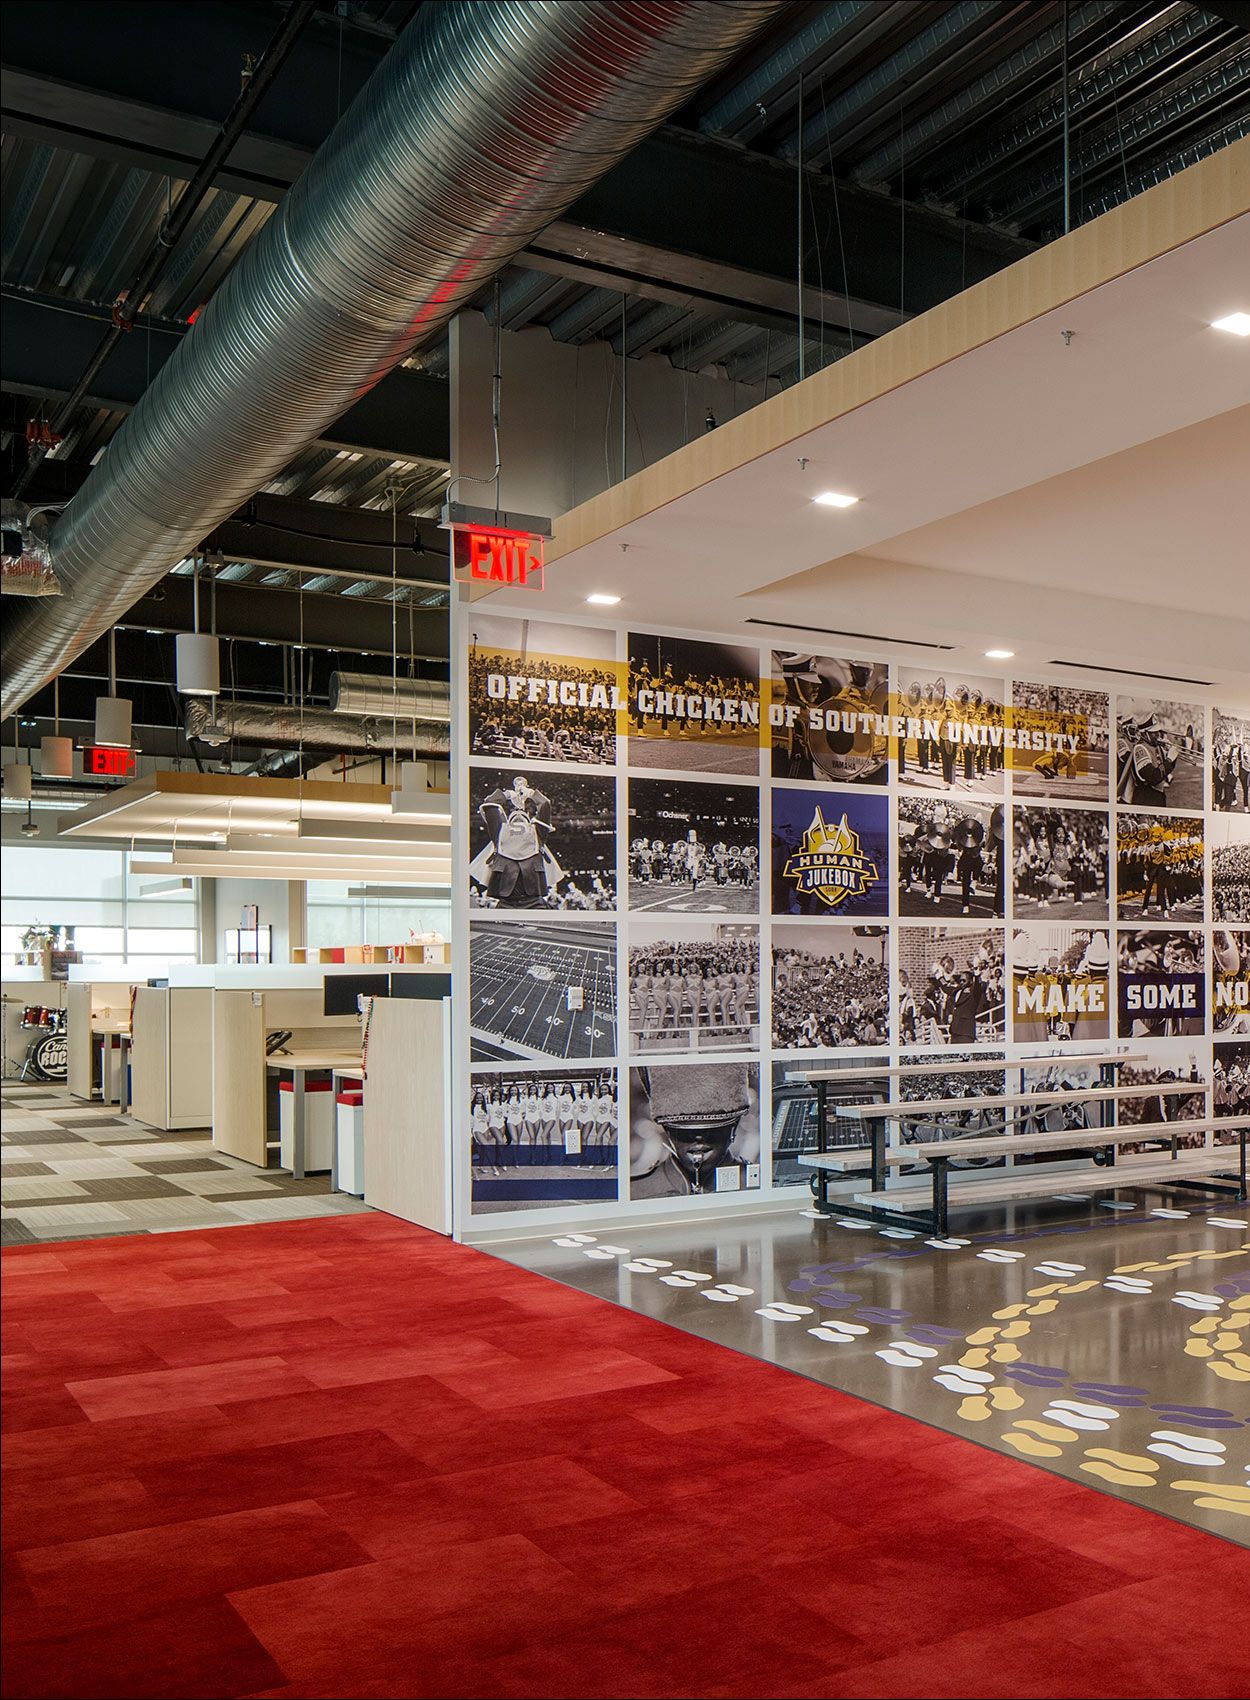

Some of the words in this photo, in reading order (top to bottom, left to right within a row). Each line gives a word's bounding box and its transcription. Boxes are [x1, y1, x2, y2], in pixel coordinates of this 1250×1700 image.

[470, 534, 530, 584] EXIT
[487, 674, 626, 710] OFFICIAL
[638, 690, 759, 724] CHICKEN
[768, 703, 801, 728] OF
[808, 705, 941, 742] SOUTHERN
[946, 724, 1080, 754] UNIVERSITY
[93, 749, 129, 775] EXIT
[832, 760, 857, 771] YAMAHA
[799, 855, 863, 869] HUMAN
[806, 868, 856, 888] JUKEBOX
[1017, 984, 1105, 1014] MAKE
[1126, 984, 1196, 1010] SOME
[511, 1005, 525, 1015] 50
[545, 1015, 560, 1026] 40
[585, 1026, 601, 1038] 30
[41, 1050, 67, 1066] ROC
